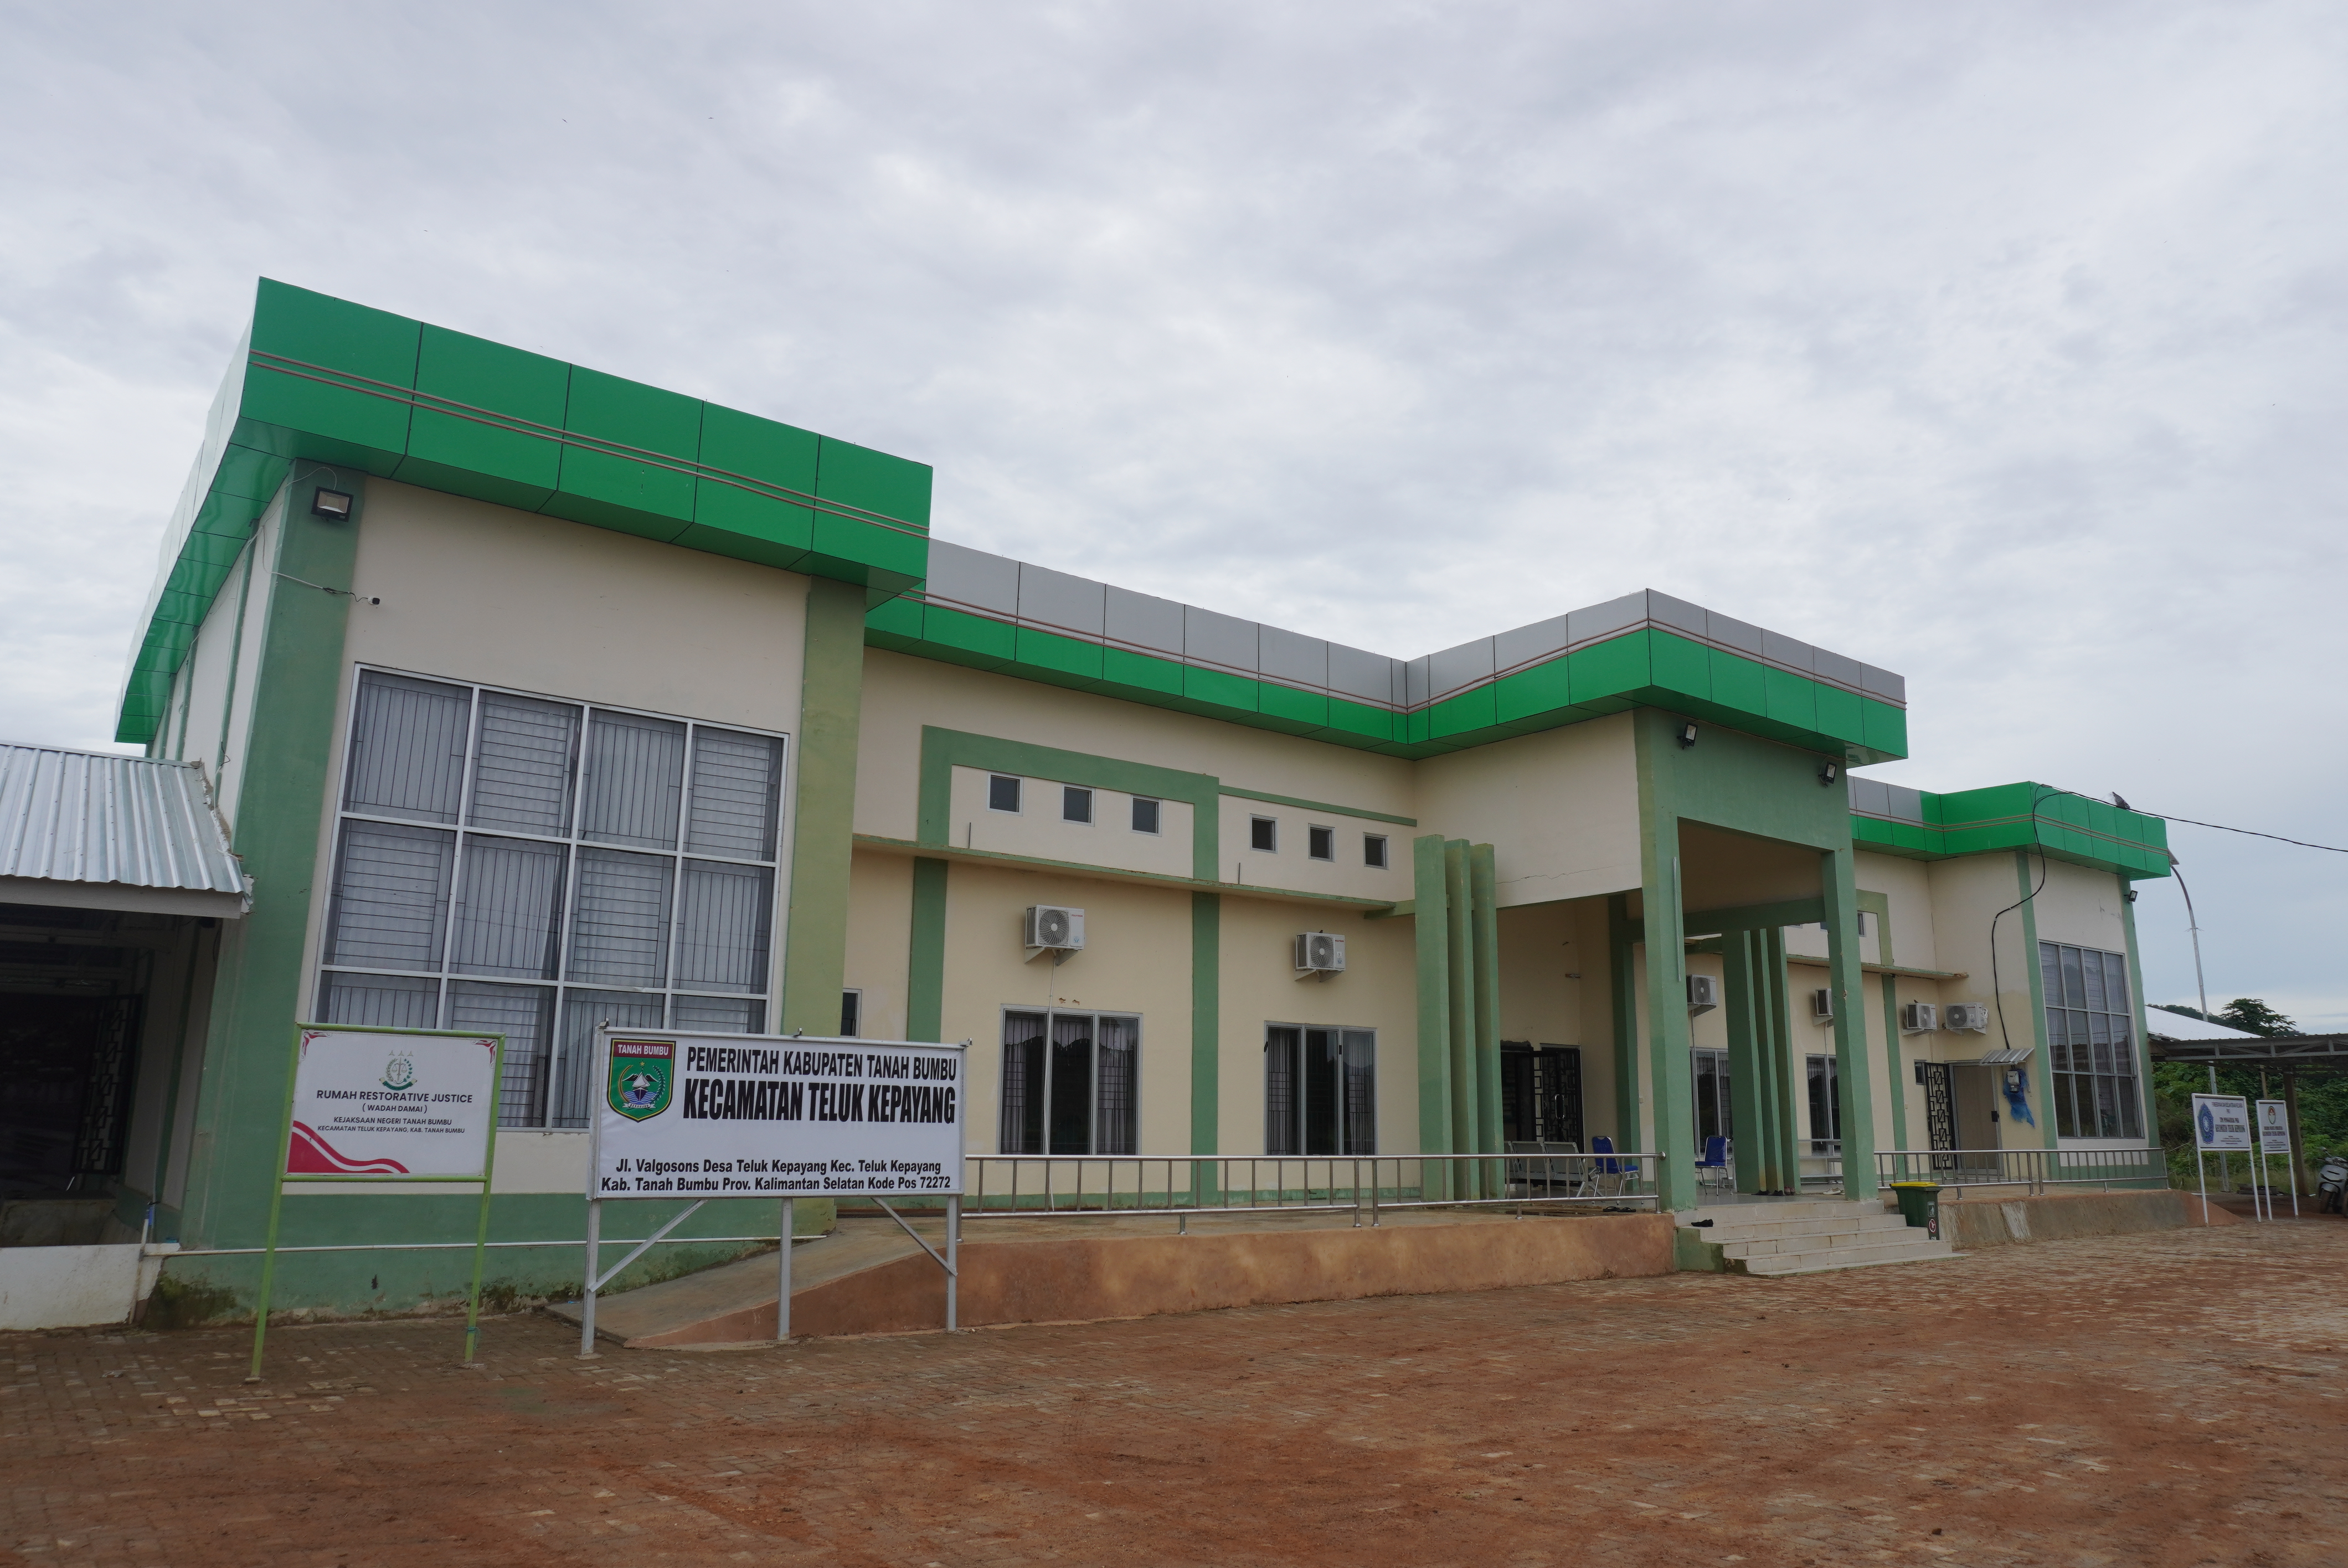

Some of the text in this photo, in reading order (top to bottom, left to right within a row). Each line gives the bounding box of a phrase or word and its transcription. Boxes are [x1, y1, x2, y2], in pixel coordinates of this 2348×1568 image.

[617, 1044, 669, 1056] TANAH BUMBU
[687, 1046, 957, 1081] PEMERINTAH KABUPATEN TANAH BUMBU
[316, 1090, 473, 1103] RUMAH RESTORATIVE JUSTICE
[683, 1078, 956, 1124] KECAMATAN TELUK KEPAYANG
[616, 1158, 941, 1176] Jl. Valgosons Desa Teluk Kepayang Kec. Teluk Kepayang
[601, 1176, 950, 1191] Kab. Tanah Bumbu Prov. Kalimantan Selatan Kode Pos 72272
